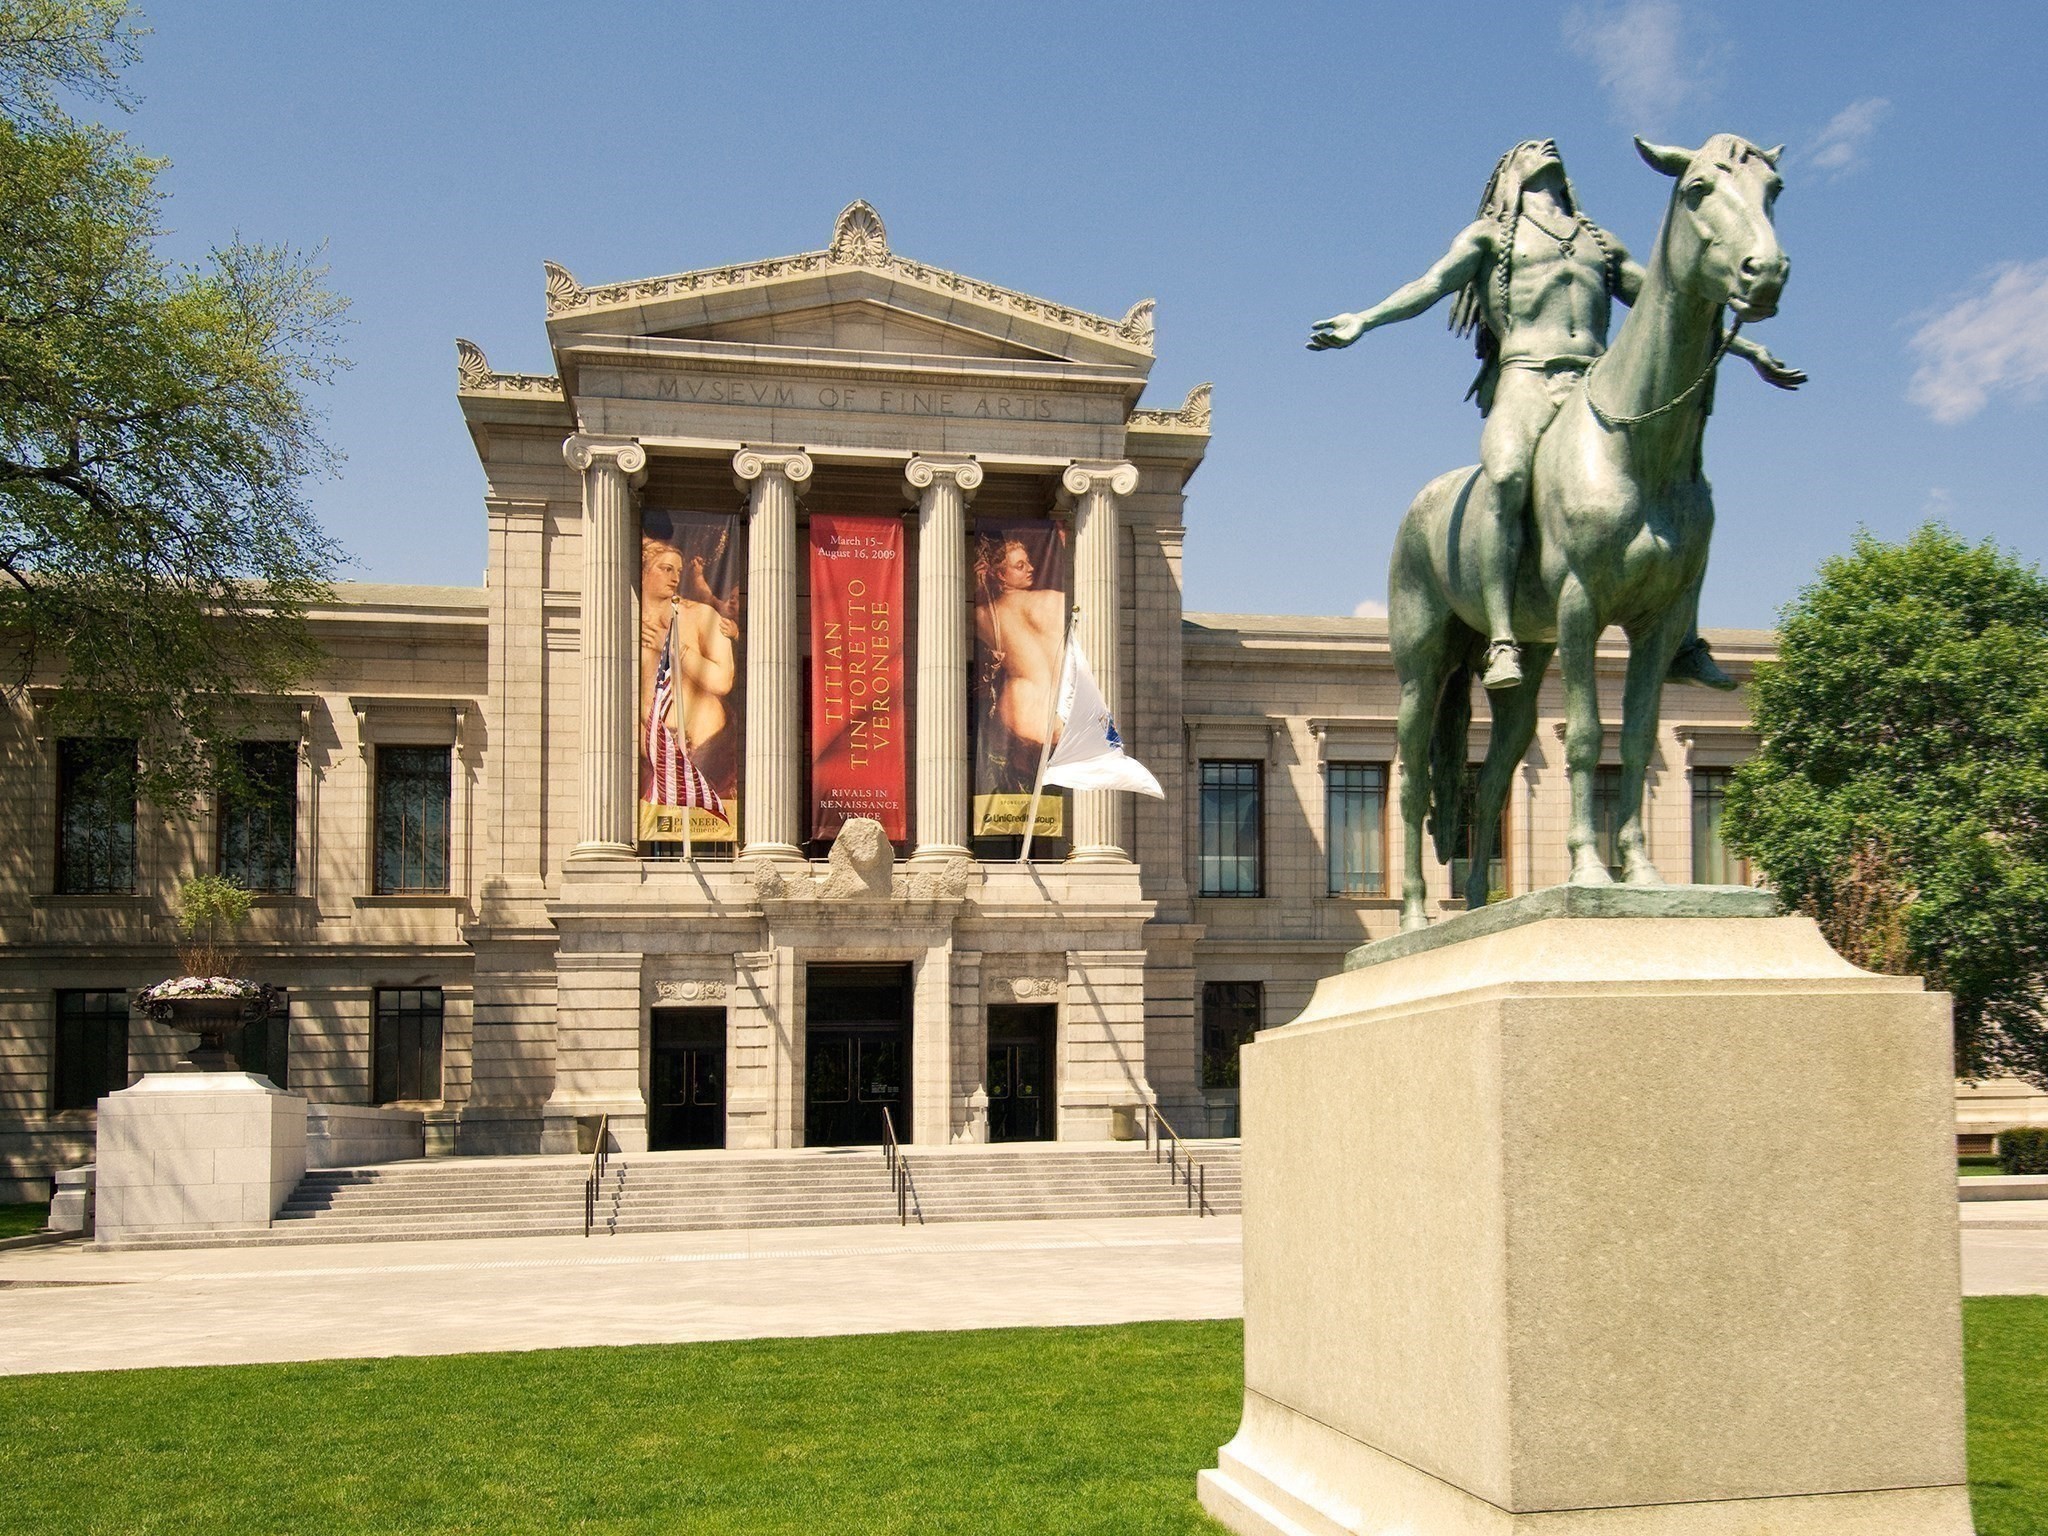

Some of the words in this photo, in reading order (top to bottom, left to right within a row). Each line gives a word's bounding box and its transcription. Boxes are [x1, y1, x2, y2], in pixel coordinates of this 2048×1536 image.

[656, 379, 795, 405] MVSEVM
[818, 387, 857, 408] OF
[879, 390, 955, 413] FINE
[973, 397, 1052, 418] ARTS
[830, 534, 861, 546] March
[817, 546, 851, 560] August
[854, 548, 869, 559] 16,
[871, 549, 896, 560] 2009
[825, 621, 843, 726] TITIAN
[848, 579, 868, 771] TINTORETTO
[871, 600, 890, 751] VERONESE
[831, 788, 872, 798] RIVALS
[875, 789, 888, 798] IN
[820, 800, 899, 810] RENAISSANCE
[674, 817, 719, 826] PINEER
[838, 811, 882, 820] VENICE
